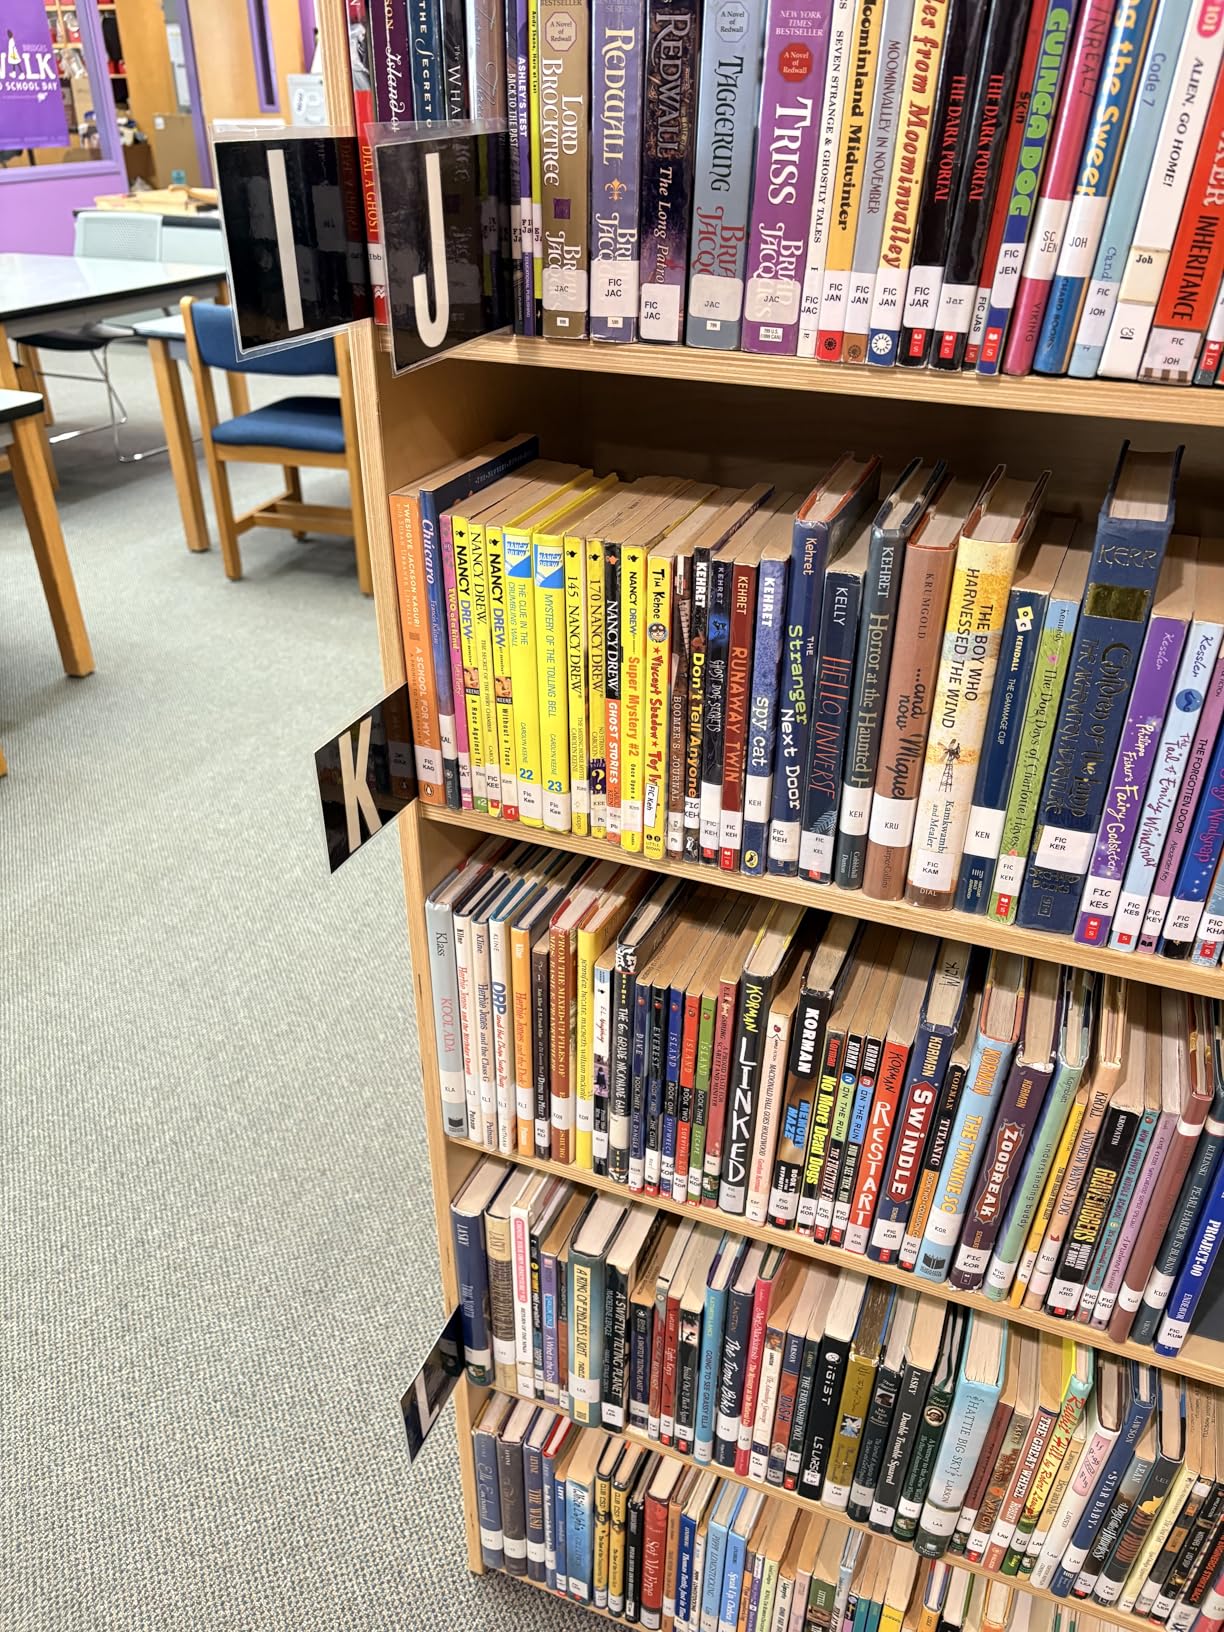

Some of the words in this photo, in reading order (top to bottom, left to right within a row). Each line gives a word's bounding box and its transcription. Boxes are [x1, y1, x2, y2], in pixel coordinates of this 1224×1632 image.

[419, 0, 427, 33] THE
[776, 28, 823, 36] BESTSELLER
[780, 10, 796, 18] NEW
[798, 11, 821, 19] YORK
[788, 19, 812, 27] TIMES
[833, 30, 844, 72] SEVEN
[912, 35, 938, 93] from
[5, 82, 40, 91] SCHOOL
[42, 82, 57, 90] DAY
[415, 38, 435, 113] SECRET
[517, 57, 527, 112] ASHLEY'S
[879, 40, 901, 133] MOOMINVALLEY
[952, 75, 967, 99] THE
[1027, 8, 1068, 137] GUINEA
[1180, 57, 1204, 108] ALIEN,
[825, 75, 839, 134] STRANGE
[945, 101, 961, 142] DARK
[519, 113, 527, 138] TEST
[561, 95, 583, 155] LORD
[825, 136, 832, 145] &
[1174, 113, 1190, 135] GO
[768, 96, 813, 207] TRISS
[881, 137, 889, 148] IN
[658, 167, 672, 191] The
[818, 149, 831, 205] GHOSTLY
[934, 145, 956, 201] PORTAL
[1163, 139, 1184, 187] HOME!
[868, 149, 887, 214] NOVEMBER
[882, 101, 930, 269] Moominvalley
[1010, 146, 1041, 216] DOG
[656, 199, 671, 238] Long
[814, 209, 825, 244] TALES
[413, 152, 449, 347] J
[1004, 250, 1019, 259] FIC
[1069, 237, 1087, 248] JOH
[1000, 265, 1017, 275] JEN
[1171, 216, 1220, 321] INHERITANCE
[605, 289, 622, 297] JAC
[825, 293, 841, 302] JAN
[829, 283, 842, 291] FIC
[851, 296, 868, 304] JAN
[855, 286, 869, 295] FIC
[910, 298, 928, 308] JAR
[914, 286, 930, 296] FIC
[644, 301, 658, 309] FIC
[644, 312, 660, 320] JAC
[456, 545, 470, 597] NANCY
[802, 538, 818, 576] Kehret
[877, 546, 895, 599] KEHRET
[489, 554, 502, 606] NANCY
[696, 562, 708, 609] KEHRET
[735, 576, 749, 615] KEHRET
[460, 598, 473, 637] DREW
[762, 577, 775, 628] KEHRET
[834, 587, 849, 626] KELLY
[918, 573, 934, 639] KRUMGOLD
[955, 568, 980, 655] HARNESSED
[976, 604, 994, 633] THE
[494, 606, 506, 647] DREW
[606, 600, 617, 646] NANCY
[867, 612, 890, 667] Horror
[806, 635, 814, 656] THE
[971, 635, 990, 664] BOY
[1009, 634, 1024, 673] KENDALL
[628, 657, 640, 691] Super
[691, 653, 705, 700] Don't
[788, 624, 808, 726] Stranger
[866, 669, 880, 686] at
[948, 659, 965, 686] THE
[965, 665, 984, 701] WHO
[729, 646, 748, 735] RUNAWAY
[863, 689, 879, 710] the
[606, 702, 616, 738] GHOST
[628, 694, 640, 742] Mystery
[691, 702, 704, 729] Tell
[753, 697, 769, 740] spy
[942, 688, 962, 729] WIND
[629, 742, 639, 756] #2
[780, 709, 797, 760] Next
[851, 711, 878, 776] Haunted
[609, 741, 618, 784] STORIES
[688, 731, 703, 798] Anyone
[724, 738, 740, 783] TWIN
[753, 741, 768, 766] cat
[807, 720, 841, 800] UNIVERSE
[338, 715, 383, 854] K
[520, 768, 534, 780] 22
[547, 780, 563, 792] 23
[785, 765, 800, 810] Door
[849, 809, 864, 818] KEH
[884, 822, 899, 830] KRU
[974, 831, 990, 840] KEN
[1088, 898, 1109, 910] KES
[1092, 888, 1112, 899] FIC
[435, 932, 446, 957] Klass
[440, 997, 453, 1030] KOOL
[743, 983, 764, 1034] KORMAN
[443, 1032, 456, 1054] ADA
[796, 1007, 820, 1074] KORMAN
[921, 1034, 943, 1078] KORMAN
[821, 1074, 836, 1094] No
[970, 1049, 1002, 1098] KORMAN
[727, 1037, 757, 1183] LINKED
[818, 1094, 833, 1124] More
[1090, 1090, 1108, 1118] KROLL
[814, 1125, 829, 1160] Dead
[892, 1089, 933, 1195] SWINDLE
[931, 1118, 951, 1166] TITANIC
[963, 1113, 984, 1141] THE
[806, 1158, 822, 1186] Dogs
[855, 1099, 891, 1226] RESTART
[947, 1142, 975, 1194] TWINKIE
[980, 1127, 1008, 1216] ZOOBREAK
[1076, 1167, 1116, 1243] GRAVEDIGGERS
[616, 1291, 626, 1299] A
[615, 1301, 626, 1334] SWIFTLY
[613, 1336, 625, 1364] TILTING
[612, 1365, 624, 1399] PLANET
[909, 1371, 921, 1395] LASKY
[415, 1375, 439, 1439] L
[898, 1412, 912, 1435] Double
[961, 1400, 979, 1436] HATTIE
[1039, 1417, 1051, 1433] THE
[1125, 1416, 1144, 1444] LAWSON
[893, 1437, 906, 1458] Trouble
[955, 1437, 968, 1454] BIG
[1026, 1435, 1044, 1468] GREAT
[886, 1459, 900, 1485] Squared
[950, 1455, 963, 1473] SKY
[942, 1480, 955, 1503] LARSON
[1013, 1469, 1032, 1499] WHEEL
[1102, 1473, 1116, 1500] STAR
[1089, 1501, 1105, 1525] BABY
